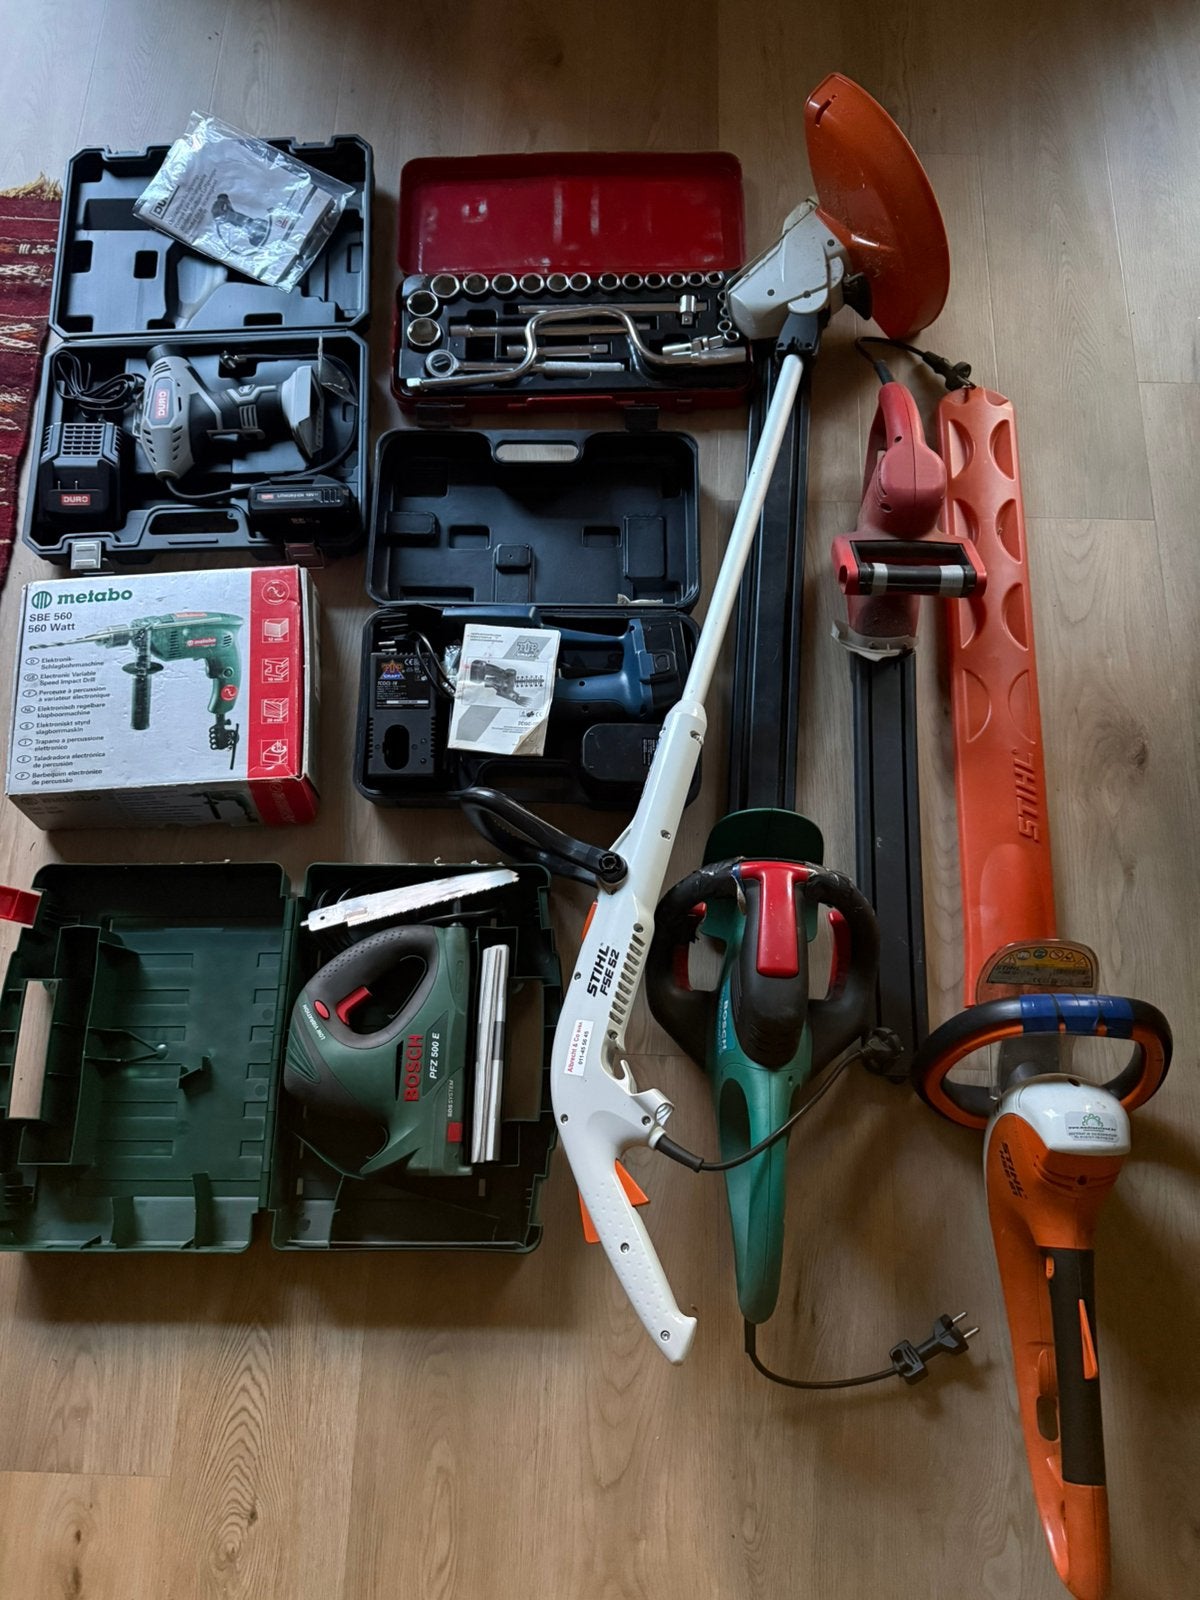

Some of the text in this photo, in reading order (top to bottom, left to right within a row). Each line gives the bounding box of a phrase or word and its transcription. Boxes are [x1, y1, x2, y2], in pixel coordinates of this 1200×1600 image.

[158, 391, 167, 417] DURO
[63, 495, 89, 503] DURO
[57, 588, 133, 605] metabo
[29, 612, 73, 623] SBE 560
[28, 622, 75, 633] 560 Watt
[41, 661, 104, 670] Schlagbohrmaschine
[37, 710, 90, 719] klopboormachine
[38, 704, 75, 712] Elektronisch
[77, 702, 106, 710] regelbare
[67, 735, 104, 743] percussione
[32, 771, 66, 779] Berbequim
[1014, 752, 1040, 843] STIHL
[587, 945, 610, 997] STIHL
[600, 949, 620, 996] FSE 52
[302, 1004, 326, 1040] LOW VIBRATION
[721, 999, 729, 1050] BOSCH
[431, 1041, 440, 1058] 500
[568, 1049, 577, 1072] Albrecht
[573, 1033, 580, 1042] Co
[578, 1047, 586, 1065] 011-45
[404, 1034, 425, 1102] BOSCH
[429, 1059, 438, 1079] PFZ
[1002, 1142, 1023, 1199] STIHL
